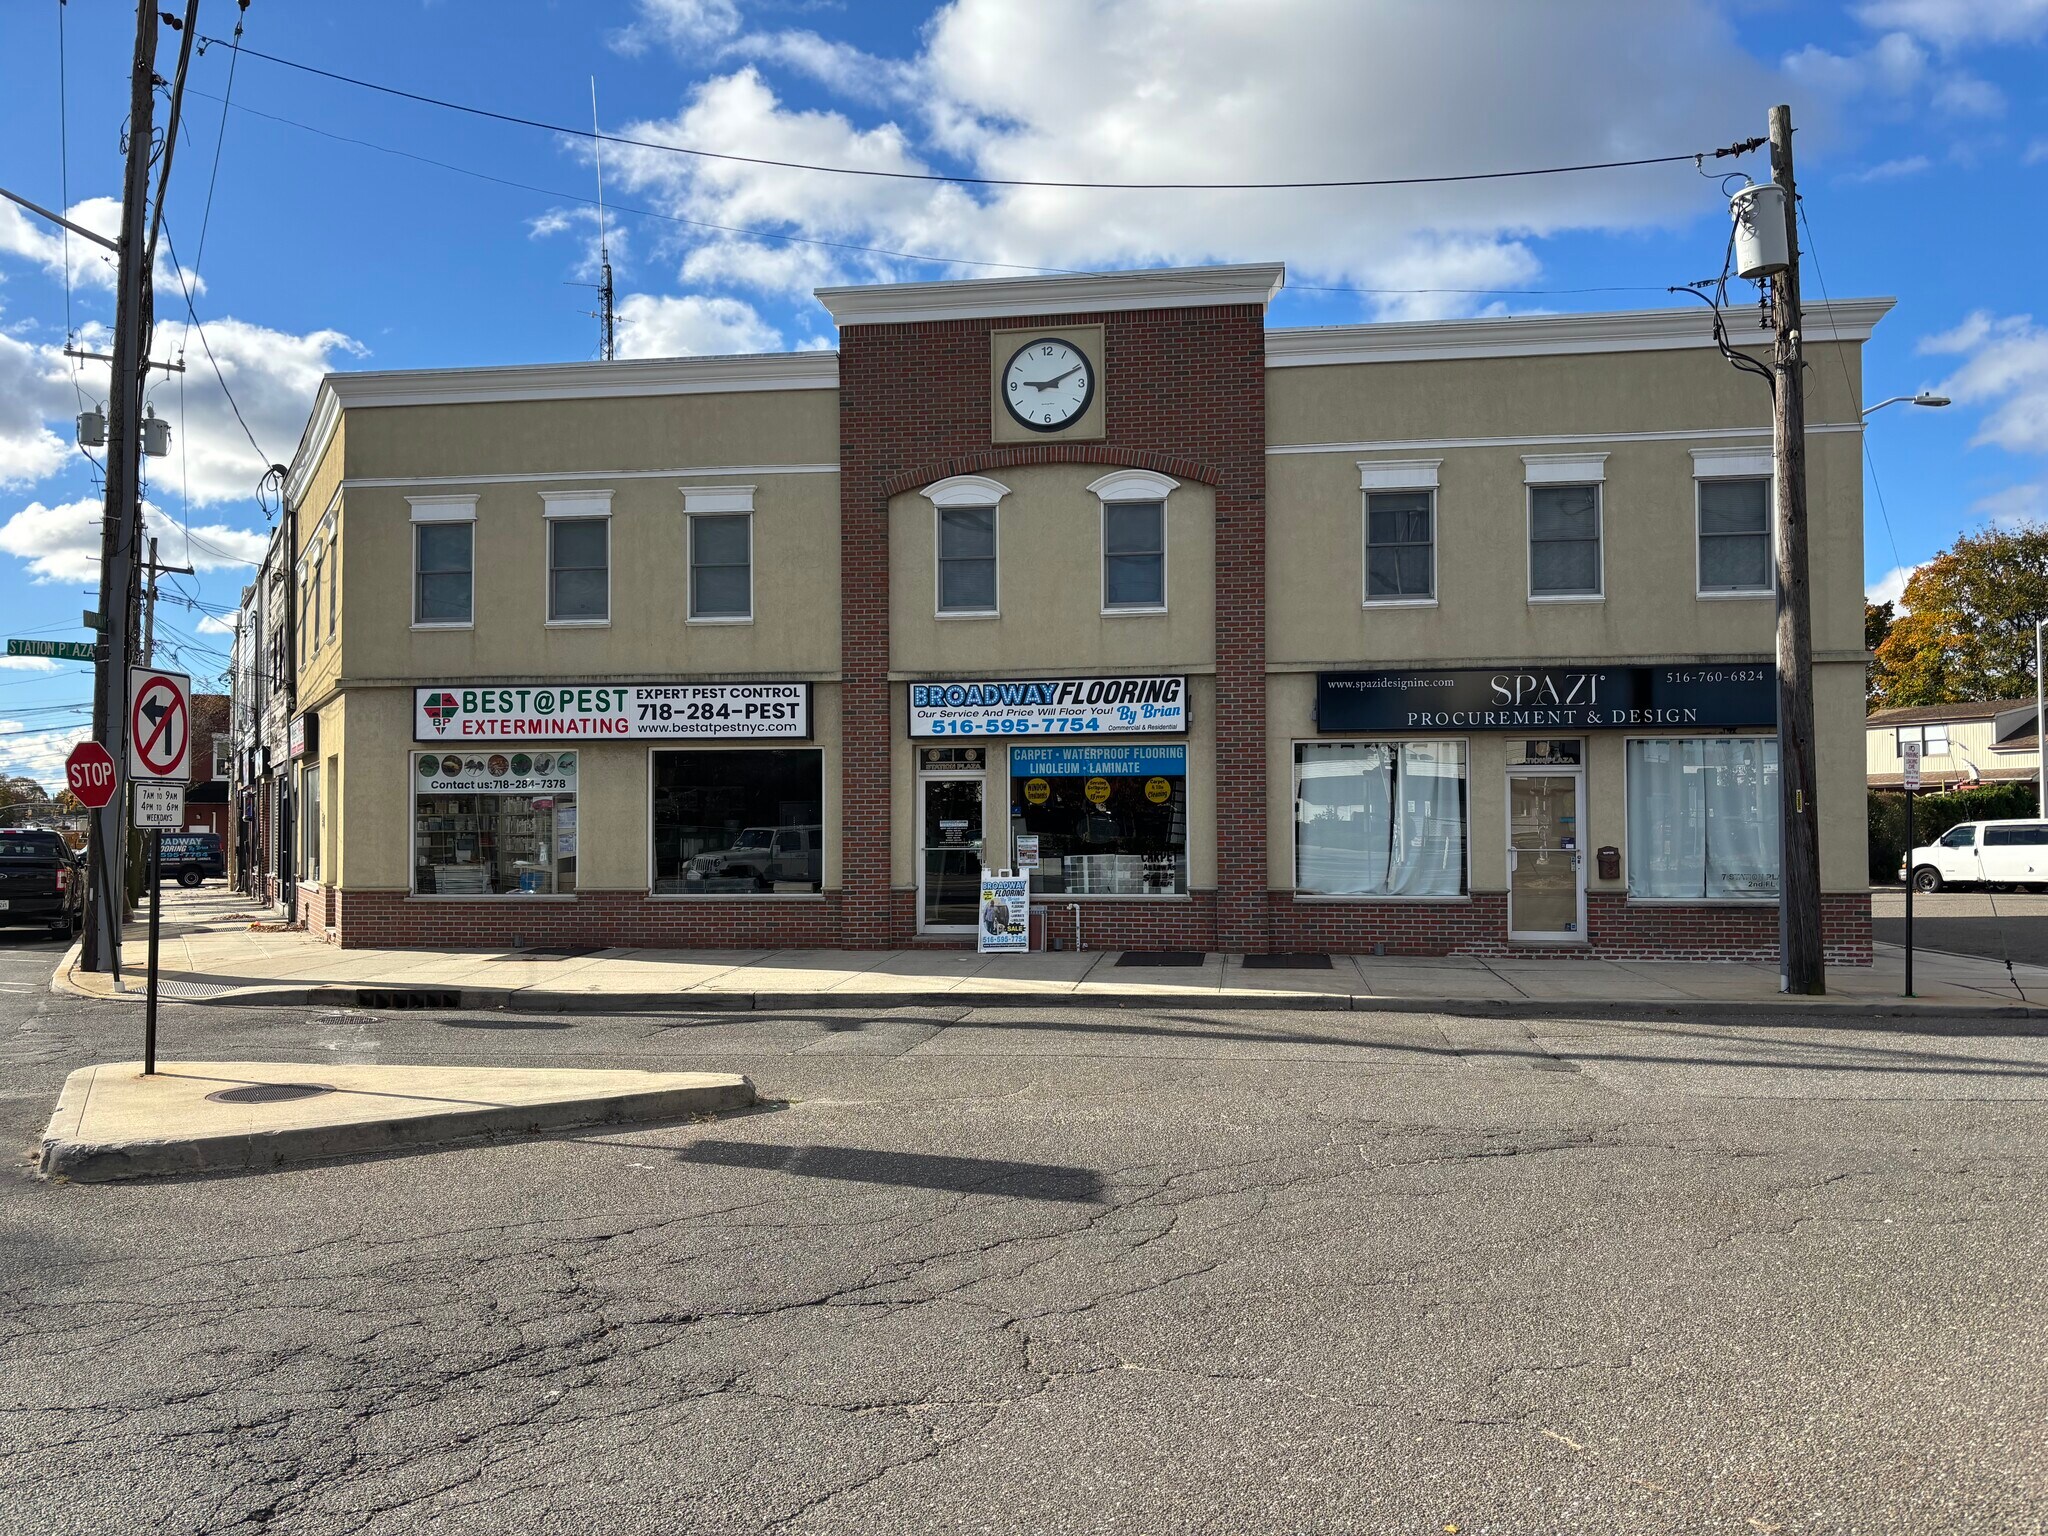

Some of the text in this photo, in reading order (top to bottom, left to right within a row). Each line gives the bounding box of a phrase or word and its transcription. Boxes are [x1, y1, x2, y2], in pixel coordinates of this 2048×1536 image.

[1042, 346, 1053, 356] 12
[1010, 382, 1018, 391] 9
[1078, 378, 1085, 388] 3
[1044, 414, 1052, 423] 6
[9, 640, 95, 658] STATION PLAZA
[1666, 670, 1764, 682] 516-760-6824
[1328, 677, 1454, 691] www.spazidesigninc.com
[1491, 674, 1598, 706] SPAZI
[636, 687, 800, 699] EXPERT PEST CONTROL
[914, 679, 1181, 707] BROADWAY FLOORING
[463, 689, 628, 715] BEST@PEST
[637, 703, 800, 720] 718-284-PEST
[940, 709, 979, 718] Service
[982, 708, 1004, 717] And
[1006, 708, 1034, 716] Price
[1038, 707, 1056, 716] Will
[1060, 707, 1087, 715] Floor
[1090, 706, 1113, 715] You!
[1117, 703, 1180, 725] By Brian
[1408, 708, 1697, 726] PROCUREMENT & DESIGN
[433, 718, 450, 726] BP
[462, 718, 629, 734] EXTERMINATING
[638, 722, 796, 734] www.bestatpestnyc.com
[932, 718, 1099, 734] 516-595-7754
[1014, 747, 1183, 760] CARPET WATERPROOF FLOORING
[1030, 762, 1140, 774] LINOLEUM LAMINATE
[70, 762, 112, 788] STOP
[431, 780, 475, 790] Contact
[143, 790, 154, 799] 7AM
[165, 791, 178, 800] 9AM
[141, 803, 154, 811] 4PM
[1141, 852, 1176, 862] CARPET
[982, 881, 1026, 890] BROADWAY
